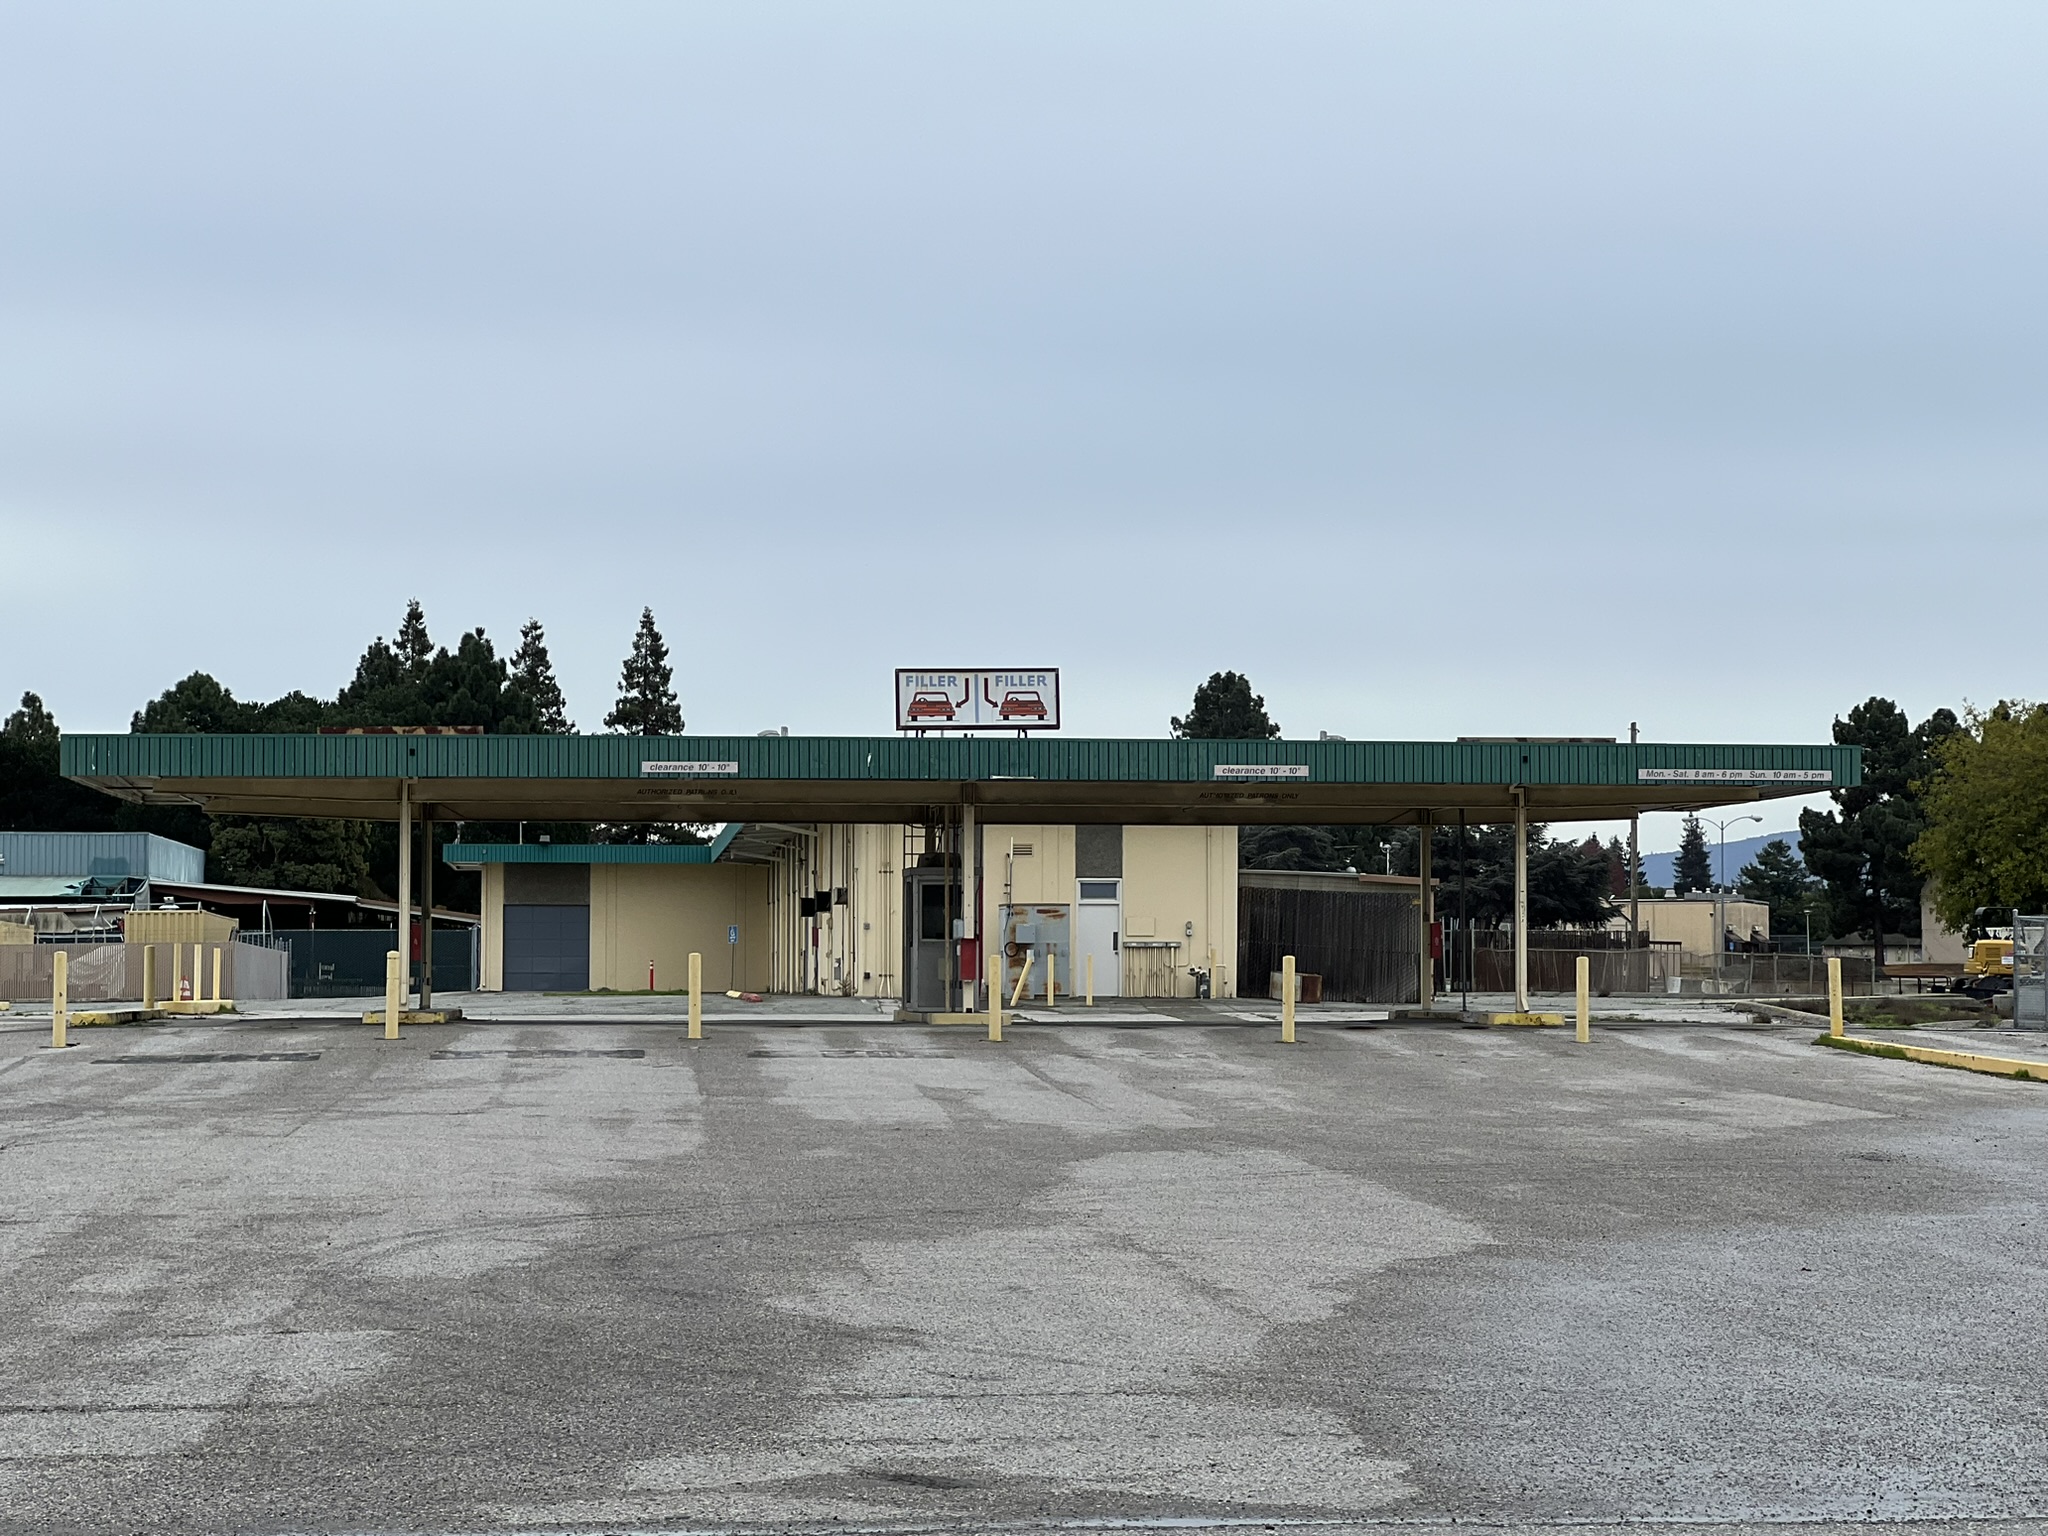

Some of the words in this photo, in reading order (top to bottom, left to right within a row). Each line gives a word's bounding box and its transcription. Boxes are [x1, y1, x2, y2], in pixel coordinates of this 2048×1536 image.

[905, 675, 958, 687] FILLER
[995, 675, 1047, 687] FILLER
[649, 763, 694, 771] clearance
[1222, 766, 1266, 775] clearance
[1645, 769, 1666, 778] Mon.
[1672, 769, 1689, 778] Sat.
[1694, 770, 1700, 778] 8
[1721, 770, 1727, 778] 6
[1729, 771, 1743, 779] pm
[1749, 770, 1767, 779] Sun.
[1772, 771, 1782, 779] 10
[1803, 771, 1809, 779] 5
[1811, 772, 1825, 780] pm
